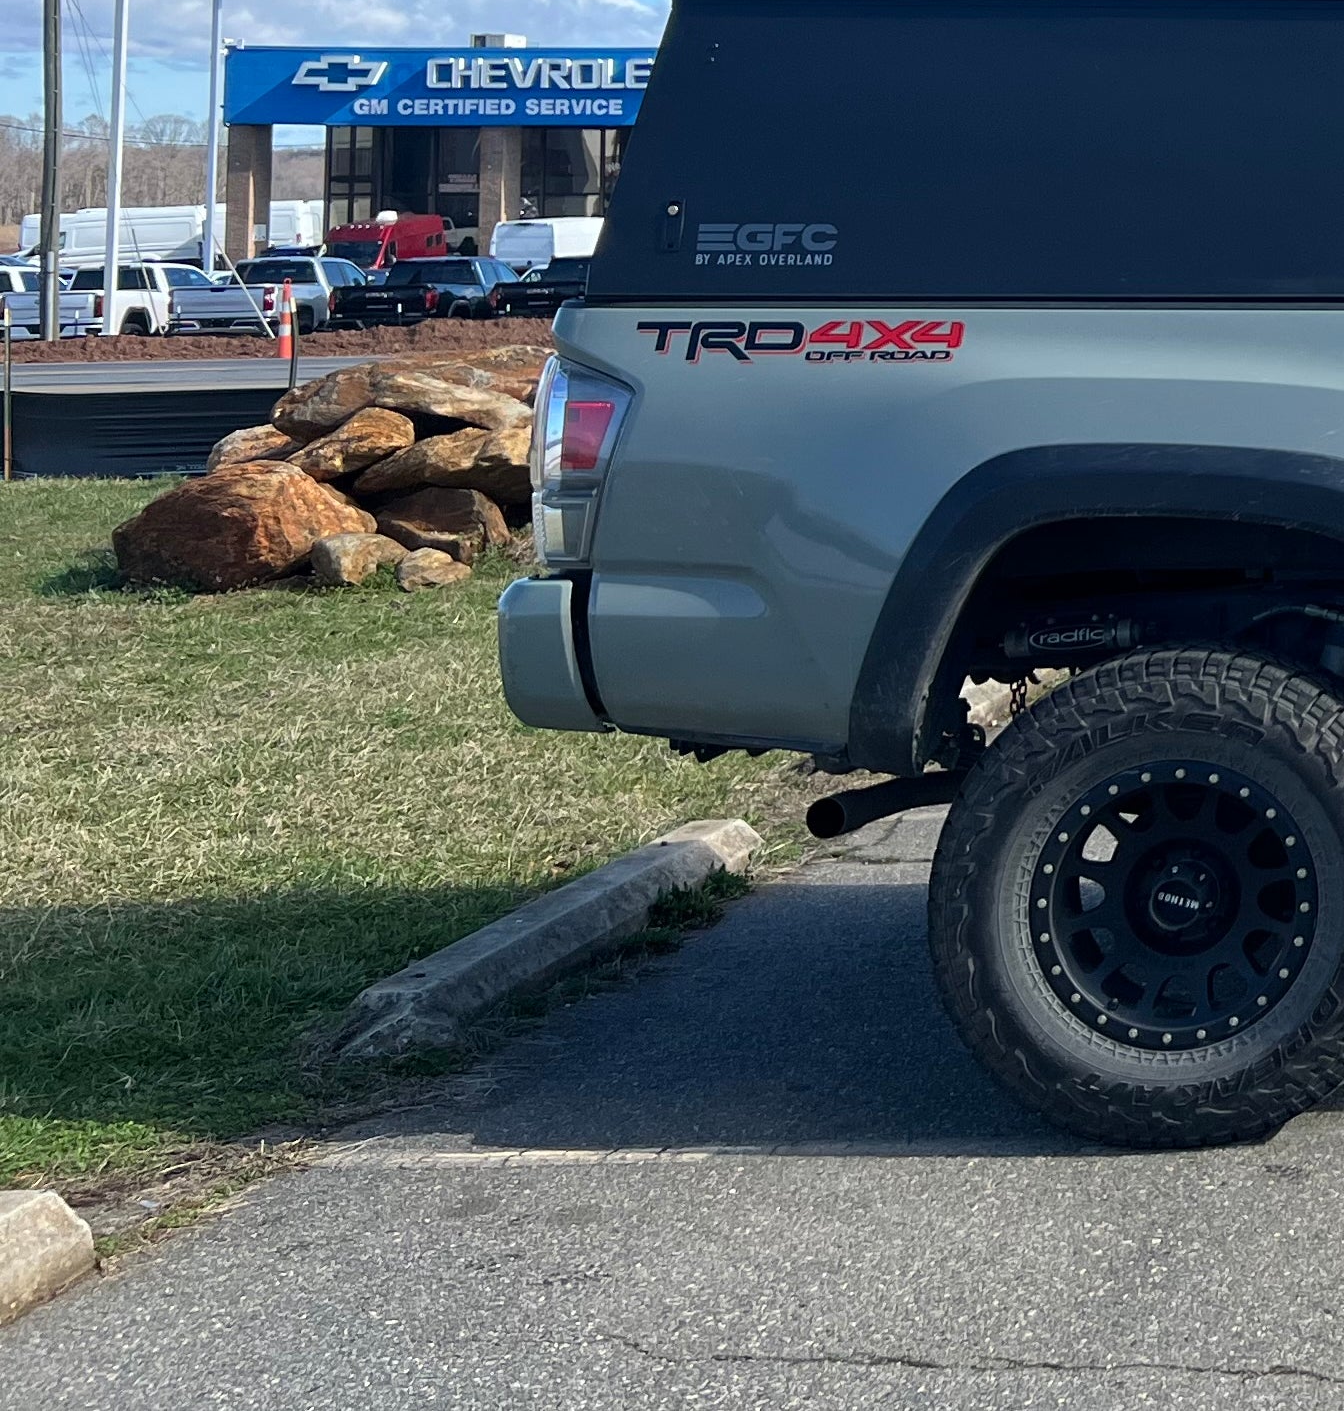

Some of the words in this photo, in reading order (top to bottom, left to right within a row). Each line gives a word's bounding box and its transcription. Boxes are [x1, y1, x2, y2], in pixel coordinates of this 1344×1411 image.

[426, 57, 654, 89] CHEVROLE
[353, 98, 389, 116] GM
[396, 98, 516, 116] CERTIFIED
[524, 98, 624, 116] SERVICE
[695, 253, 712, 266] BY
[716, 253, 753, 266] APEX
[758, 253, 834, 266] OVERLAND
[636, 321, 808, 364] TRD
[804, 350, 864, 364] OFF
[868, 350, 954, 364] ROAD
